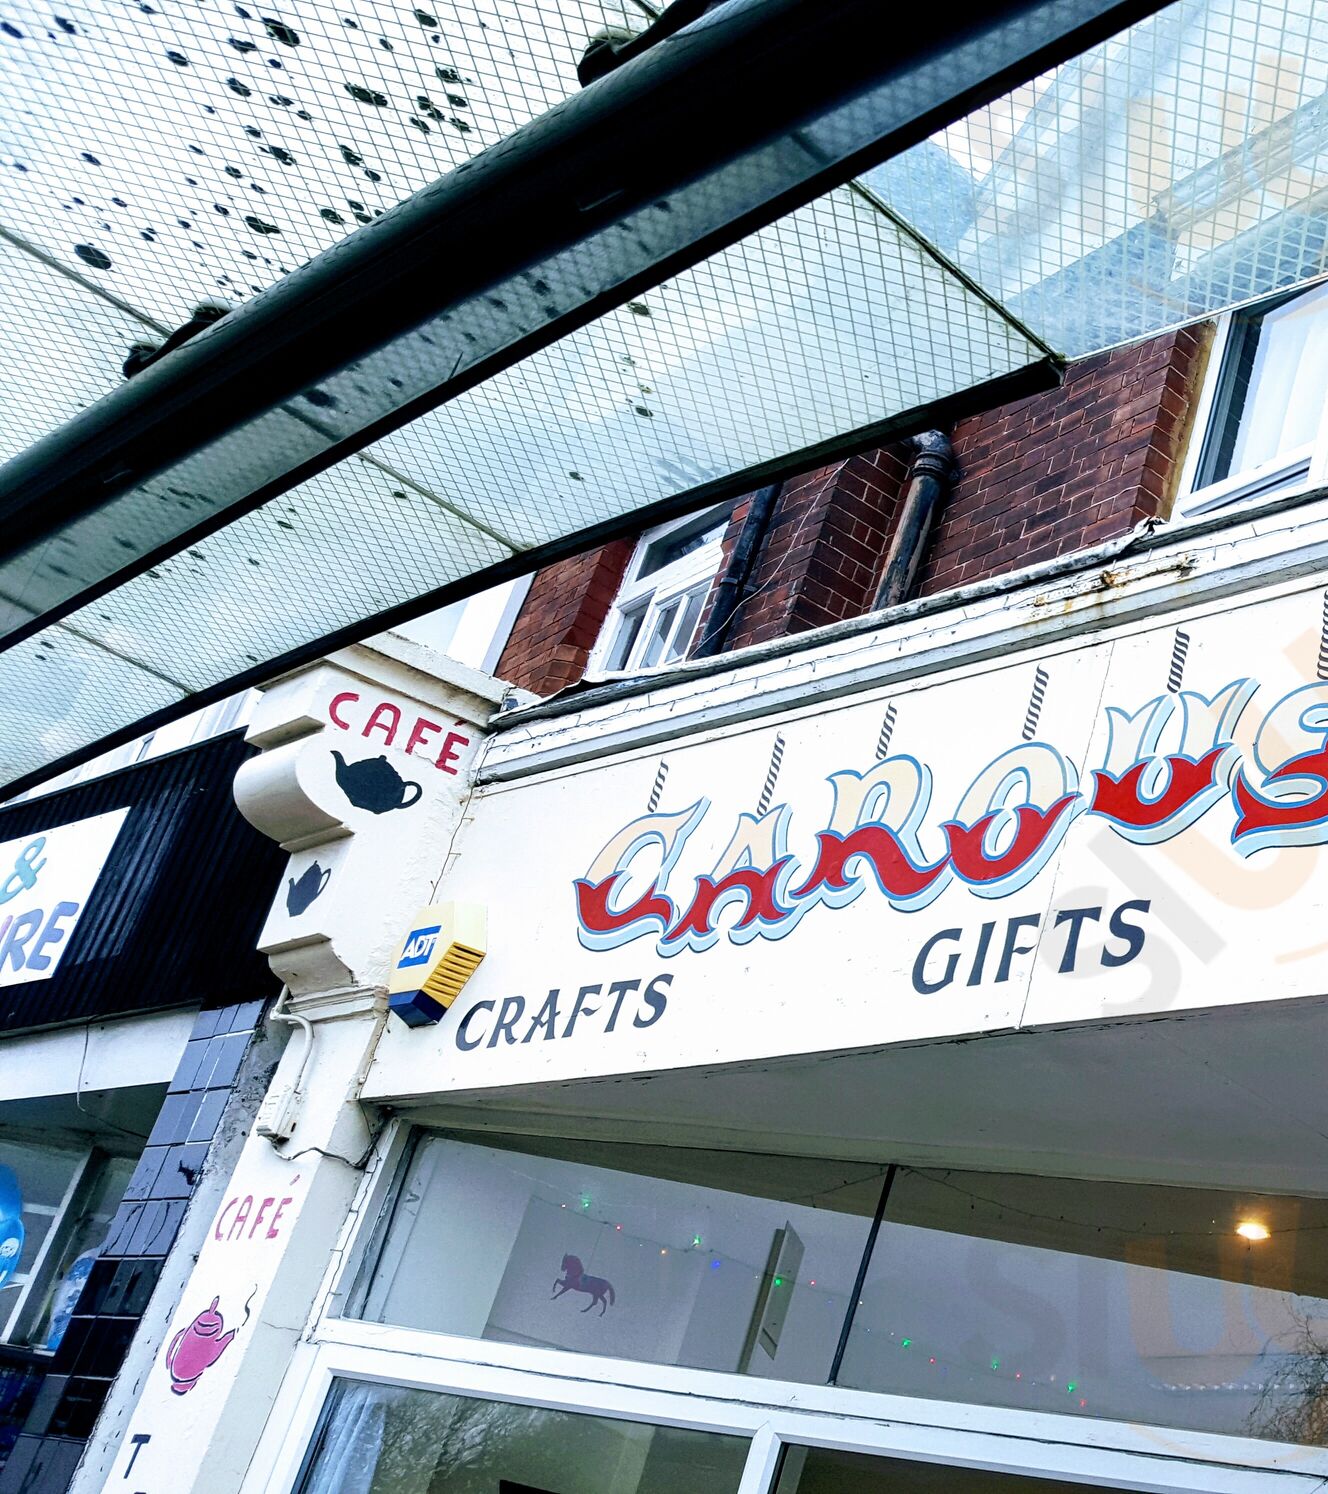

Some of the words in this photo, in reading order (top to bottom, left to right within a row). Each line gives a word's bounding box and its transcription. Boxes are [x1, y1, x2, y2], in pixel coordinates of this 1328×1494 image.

[329, 692, 470, 775] CAFÉ
[0, 837, 47, 905] &
[0, 901, 80, 972] RE
[402, 932, 440, 959] ADT
[912, 900, 1150, 994] GIFTS
[455, 973, 674, 1051] CRAFTS
